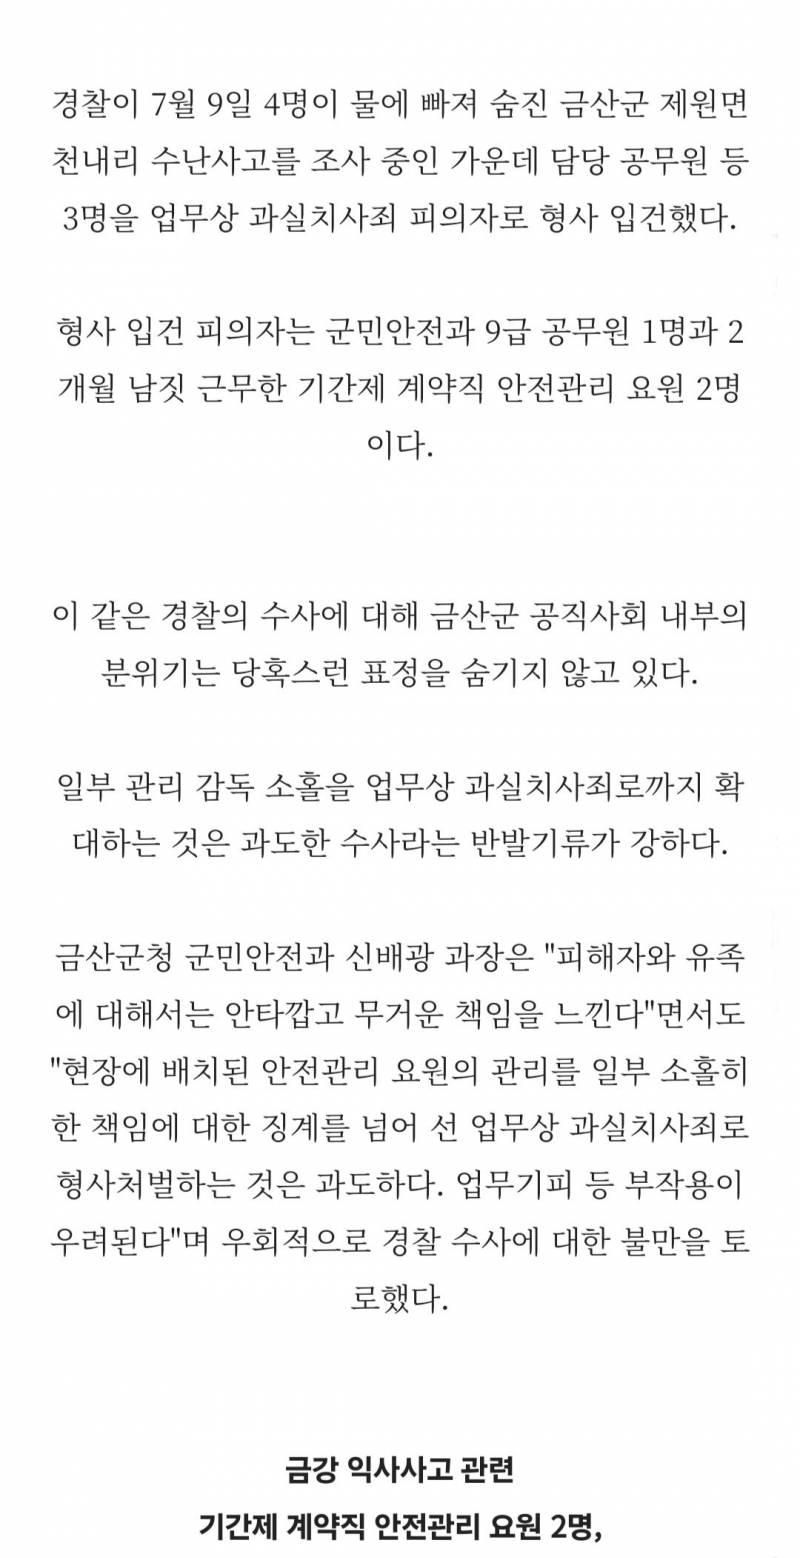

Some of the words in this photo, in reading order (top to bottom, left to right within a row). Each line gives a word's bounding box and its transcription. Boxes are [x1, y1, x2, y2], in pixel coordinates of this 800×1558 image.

[52, 87, 138, 120] 경찰이
[151, 87, 196, 120] 7월
[207, 87, 252, 119] 9일
[263, 87, 337, 120] 4명이
[349, 87, 408, 120] 물에
[420, 87, 477, 120] 빠져
[489, 87, 548, 120] 숨진
[559, 87, 650, 120] 금산군
[659, 87, 748, 120] 제원면
[285, 1455, 340, 1485] 금강
[347, 1455, 454, 1485] 익사사고
[460, 1455, 514, 1484] 관련
